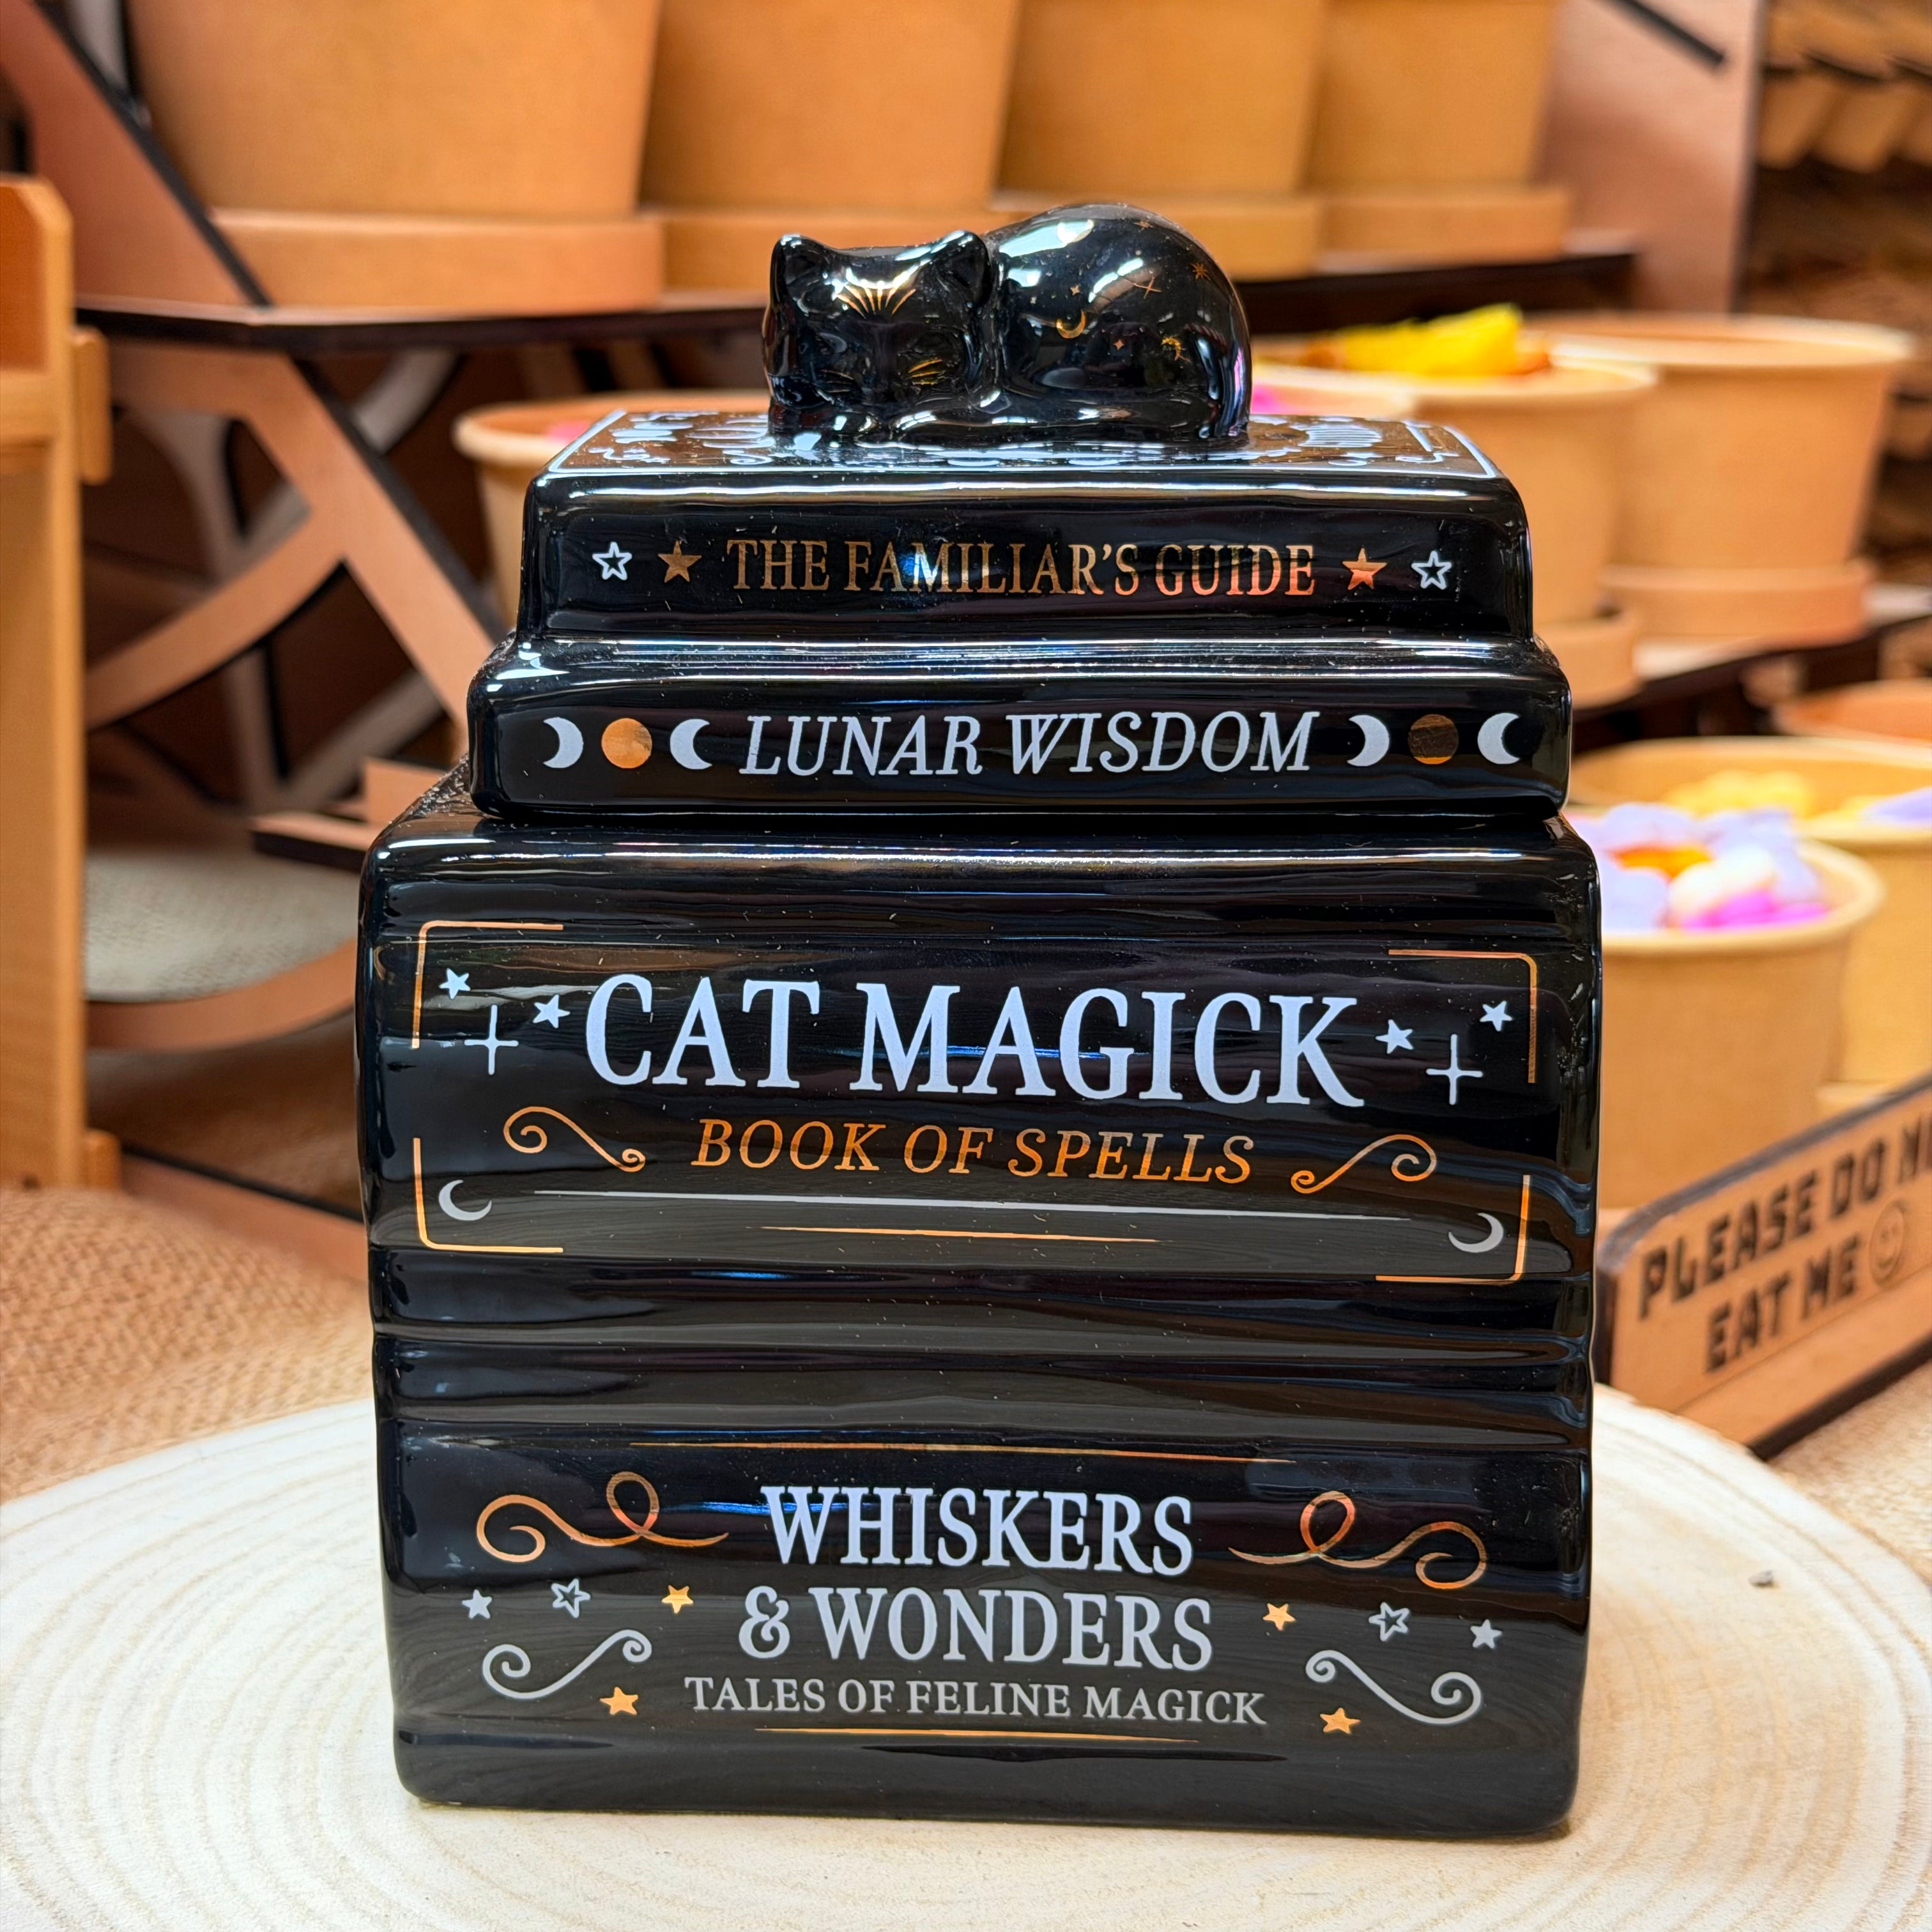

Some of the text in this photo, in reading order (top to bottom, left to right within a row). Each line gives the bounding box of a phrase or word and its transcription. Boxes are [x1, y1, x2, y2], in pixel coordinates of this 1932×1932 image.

[727, 539, 1315, 596] THE FAMILIAR'S GUIDE
[739, 710, 1321, 776] LUNAR WISDOM
[586, 973, 1365, 1108] CAT MAGICK
[690, 1119, 1254, 1184] BOOK OF SPELLS
[1639, 1169, 1818, 1321] PLEASE
[1830, 1137, 1886, 1217] DO
[1706, 1233, 1861, 1374] EAT ME
[760, 1485, 1193, 1576] WHISKERS
[738, 1585, 1213, 1671] & WONDERS
[684, 1676, 1268, 1726] TALES OF FELINE MAGICK
